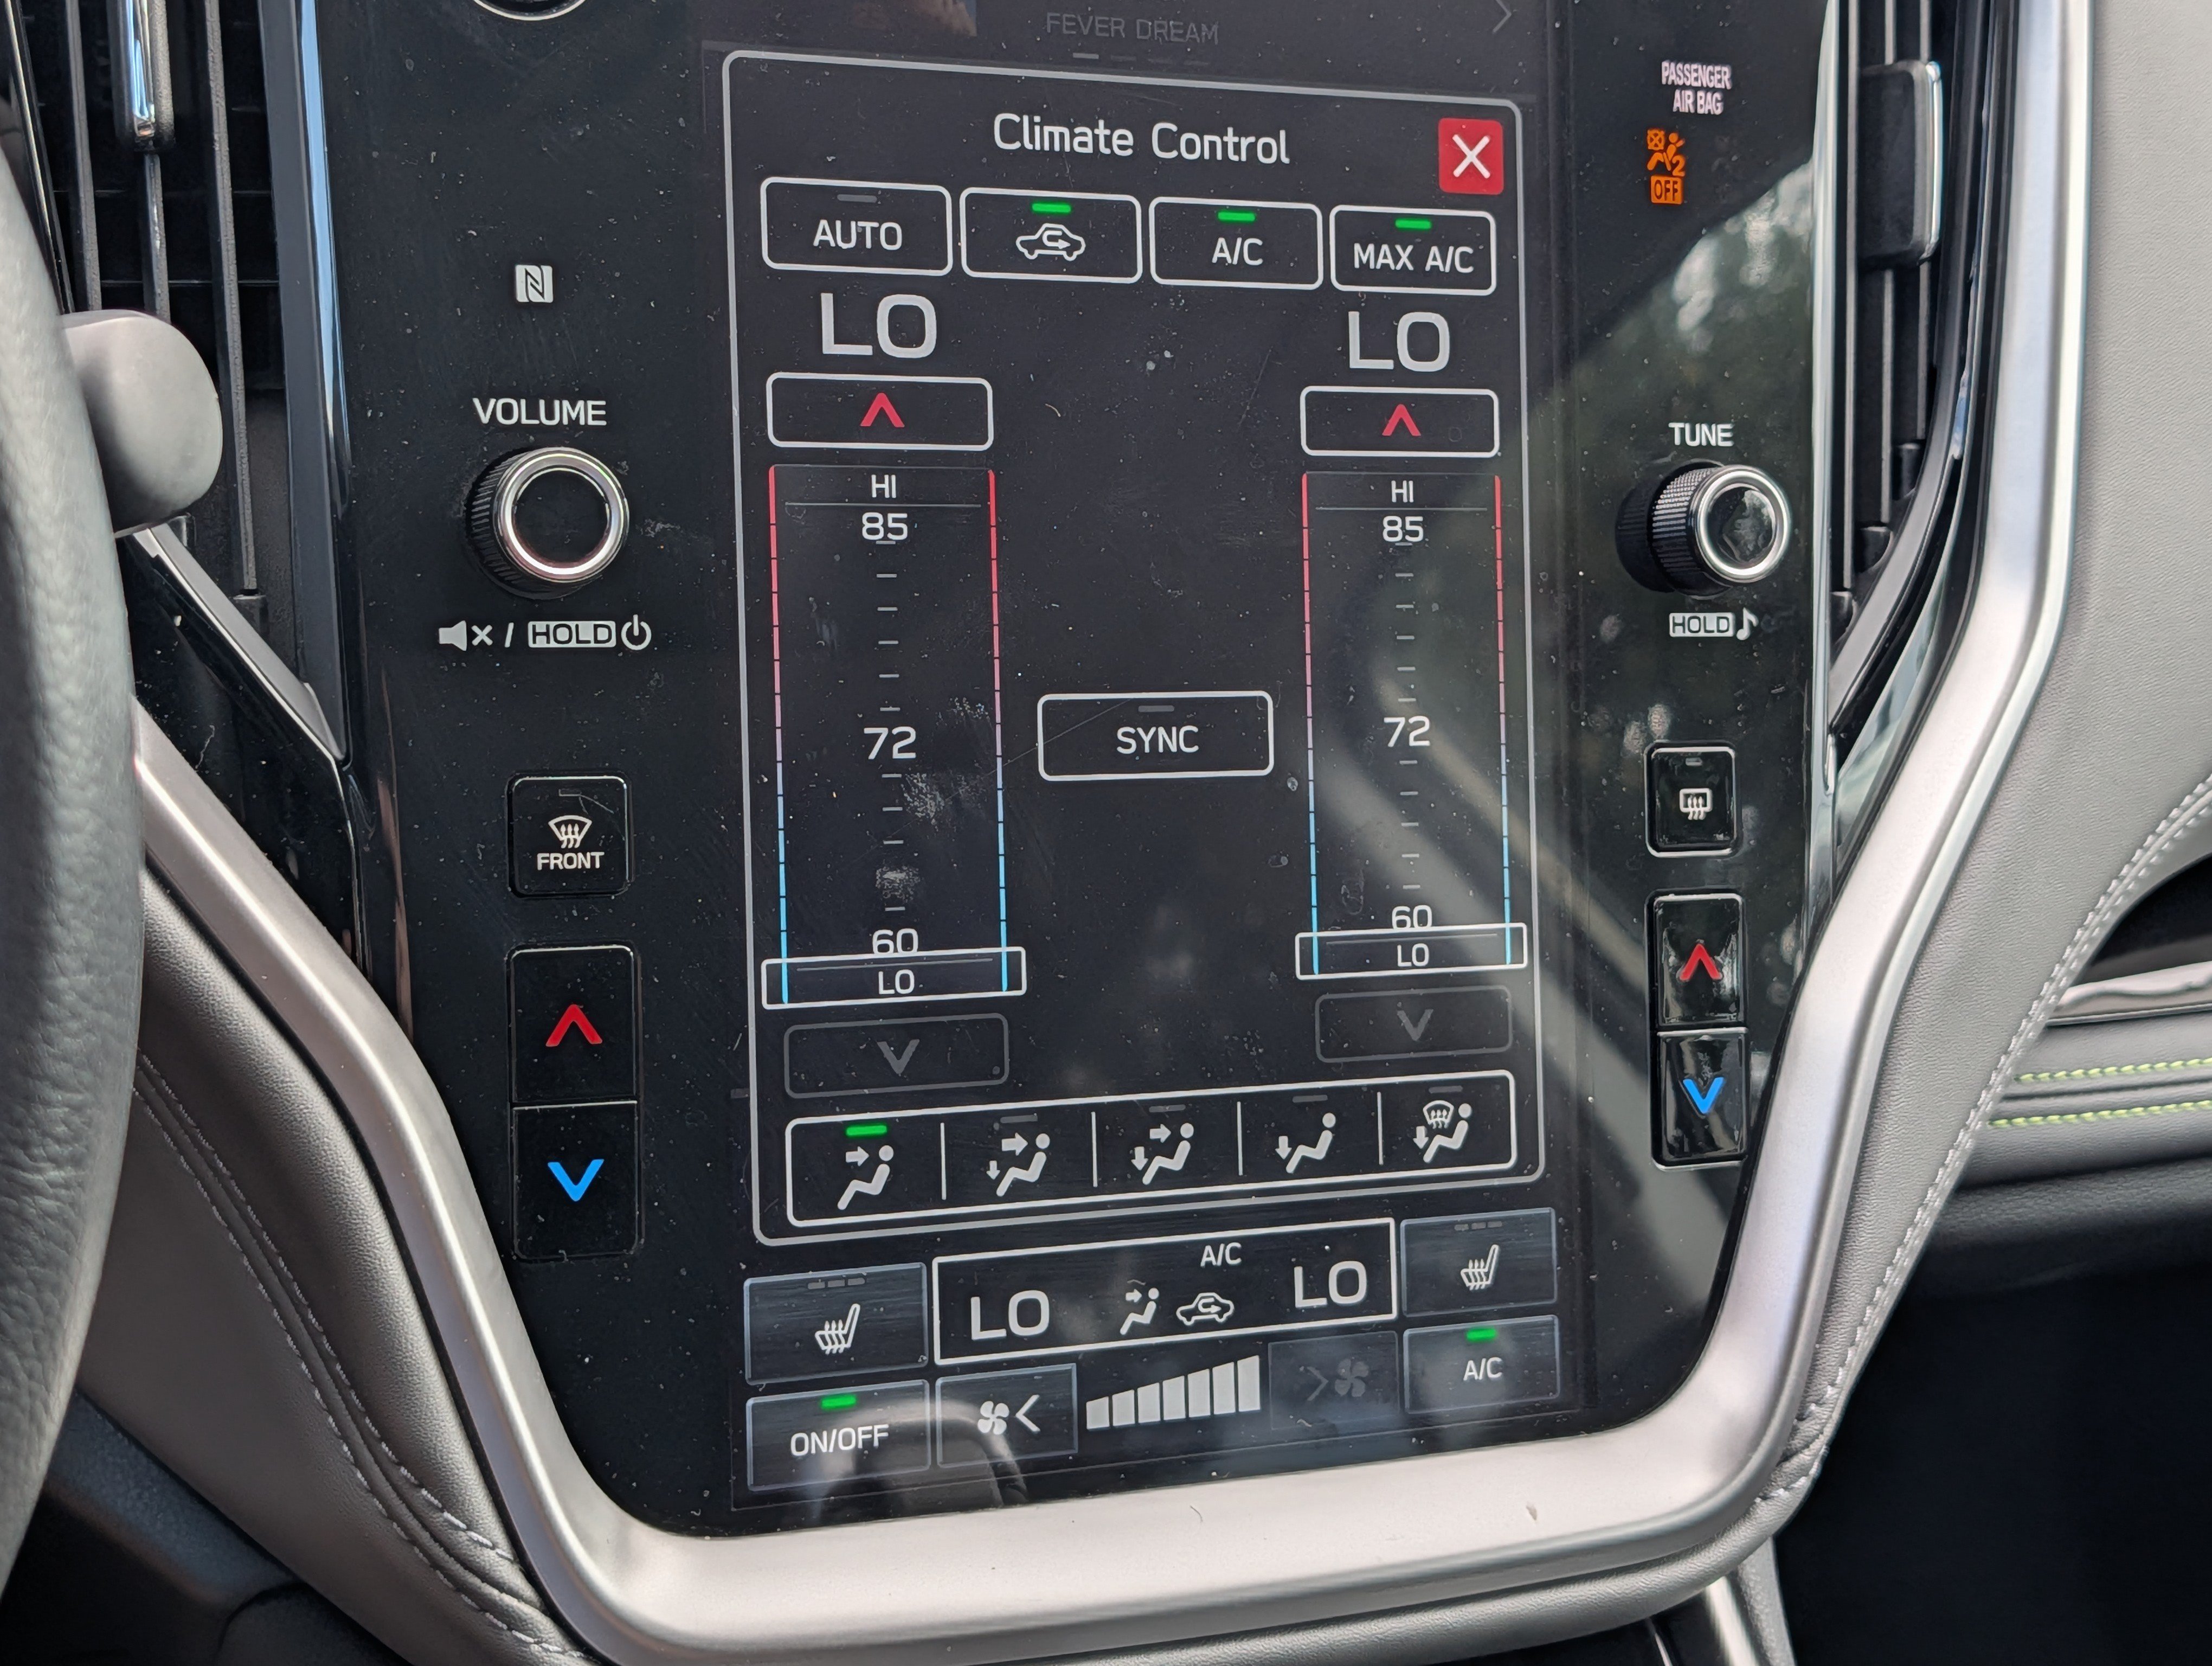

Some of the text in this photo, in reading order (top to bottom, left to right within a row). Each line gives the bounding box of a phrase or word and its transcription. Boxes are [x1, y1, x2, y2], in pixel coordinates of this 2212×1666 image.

[1046, 12, 1219, 44] FEVER DREAM
[1661, 60, 1732, 89] PASSENGER
[1673, 89, 1723, 114] AIR BAG
[994, 113, 1290, 164] Climate Control
[1654, 180, 1678, 200] OFF
[813, 220, 902, 250] AUTO
[1212, 238, 1263, 265] A/C
[1354, 243, 1474, 273] MAX A/C
[821, 293, 937, 358] LO
[1348, 311, 1450, 372] LO
[473, 398, 607, 426] VOLUME
[1669, 422, 1734, 447] TUNE
[871, 475, 896, 498] HI
[1391, 480, 1413, 502] HI
[862, 512, 908, 540] 85
[1382, 516, 1423, 542] 85
[532, 624, 612, 644] HOLD
[1673, 616, 1729, 633] HOLD
[864, 727, 916, 759] 72
[1117, 726, 1199, 754] SYNC
[1384, 716, 1430, 747] 72
[537, 852, 605, 870] FRONT
[1391, 905, 1432, 929] 60
[872, 928, 918, 953] 60
[1397, 943, 1429, 967] LO
[878, 970, 915, 994] LO
[1201, 1242, 1242, 1267] A/C
[1294, 1261, 1367, 1308] LO
[971, 1290, 1050, 1340] LO
[1463, 1357, 1502, 1381] A/C
[790, 1424, 890, 1457] ON/OFF
